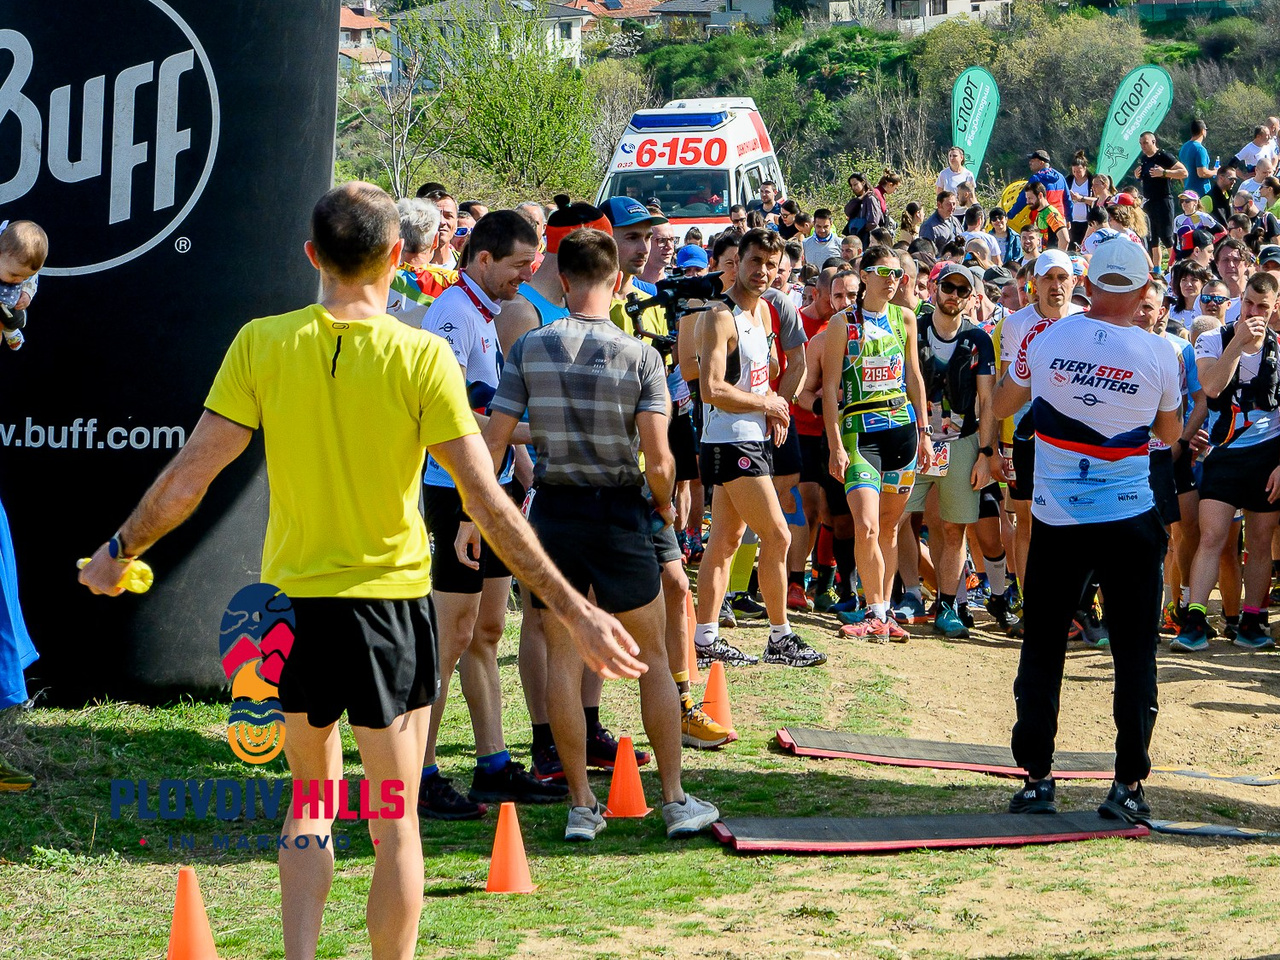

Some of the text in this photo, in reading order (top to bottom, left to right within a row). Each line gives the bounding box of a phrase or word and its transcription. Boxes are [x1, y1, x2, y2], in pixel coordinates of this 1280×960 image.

[864, 367, 889, 381] 2195
[1049, 358, 1134, 382] EVERY STEP
[1070, 373, 1140, 395] MATTERS
